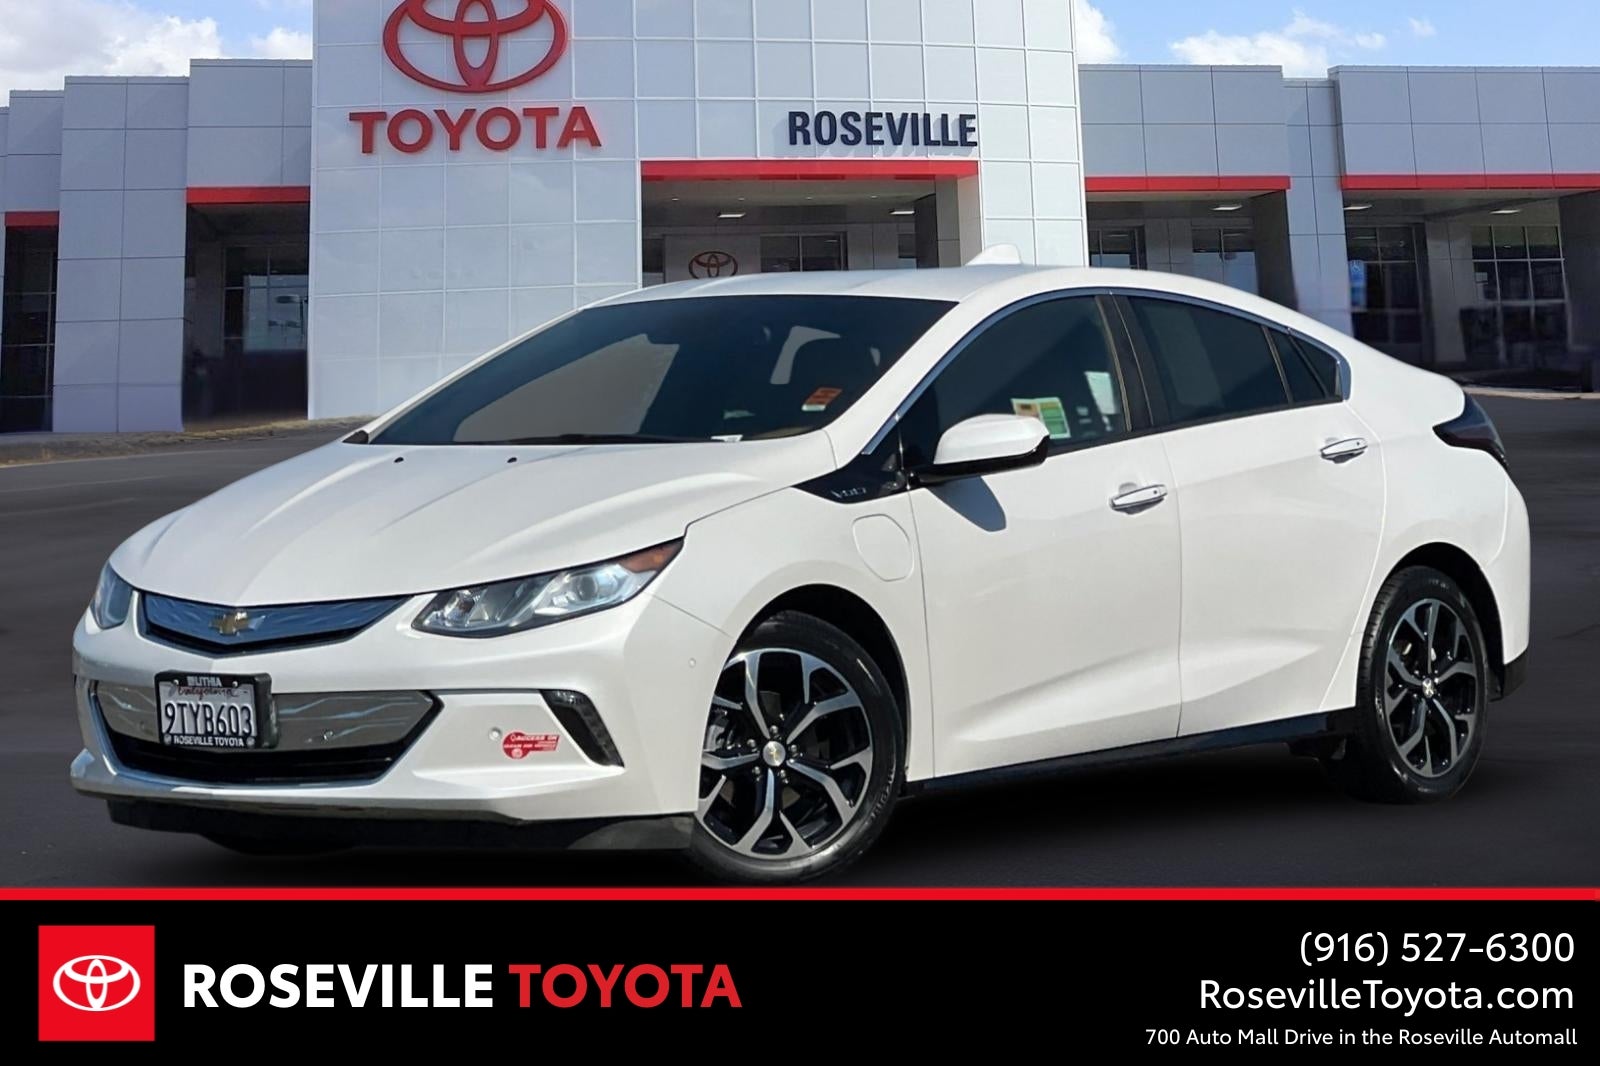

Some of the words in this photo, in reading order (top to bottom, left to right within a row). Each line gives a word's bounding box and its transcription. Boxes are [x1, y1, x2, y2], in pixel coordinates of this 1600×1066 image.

[349, 106, 602, 154] TOYOTA
[788, 110, 978, 147] ROSEVILLE
[164, 702, 253, 736] 9TYB603
[173, 736, 213, 746] ROSEVILLE
[214, 737, 244, 747] TOYOTA
